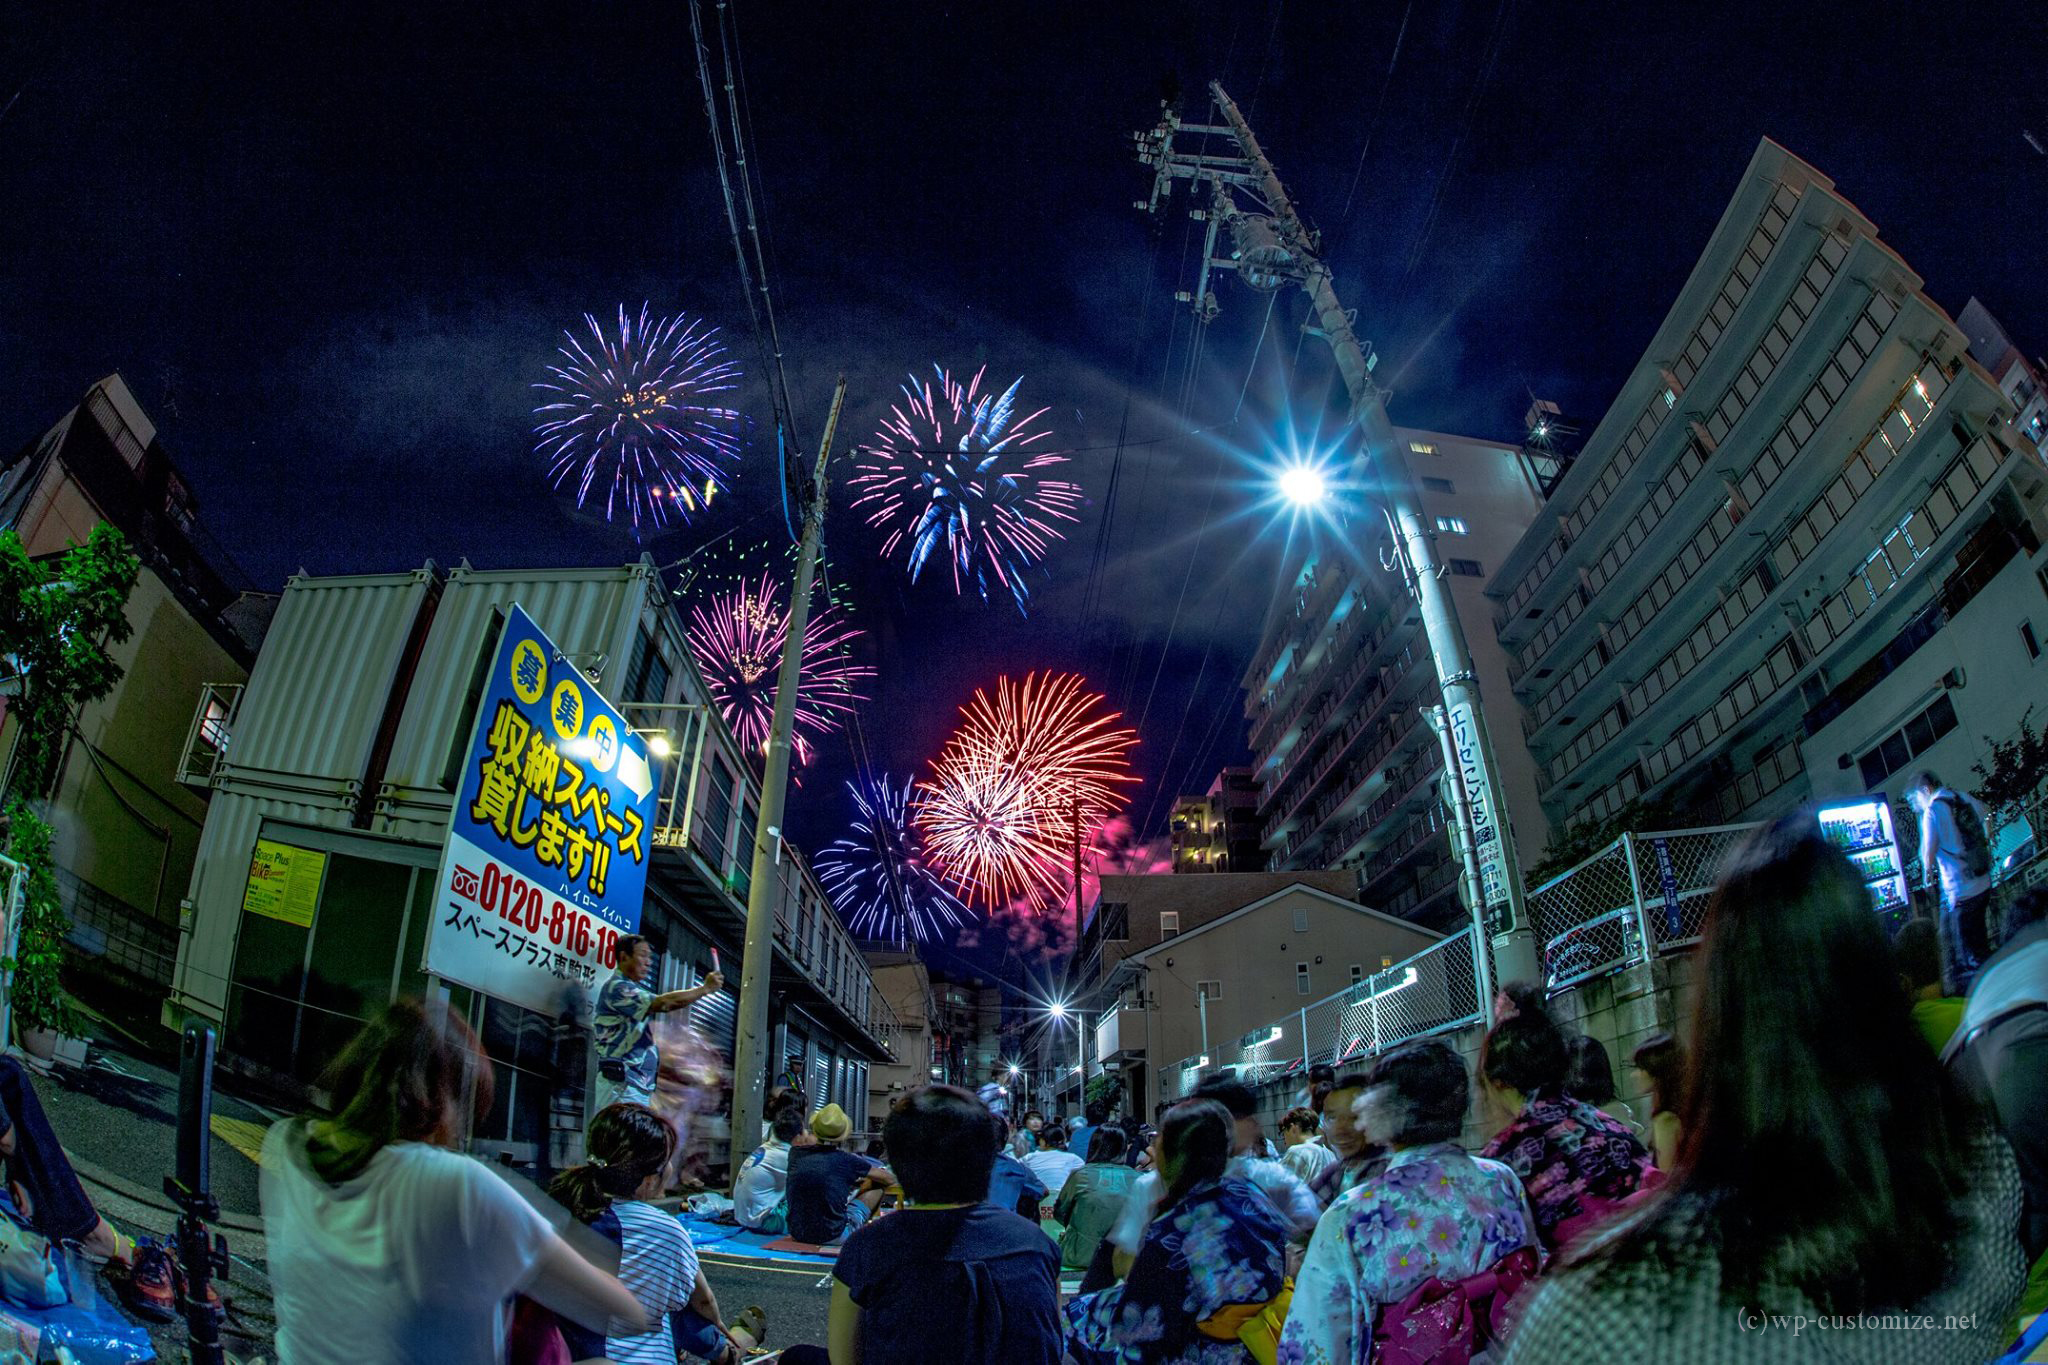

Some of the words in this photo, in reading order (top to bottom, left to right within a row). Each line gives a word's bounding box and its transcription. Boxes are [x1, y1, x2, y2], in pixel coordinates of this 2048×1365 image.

[517, 646, 612, 760] 募集中
[487, 703, 646, 862] 収納スペース
[1451, 710, 1488, 826] エリゼこども
